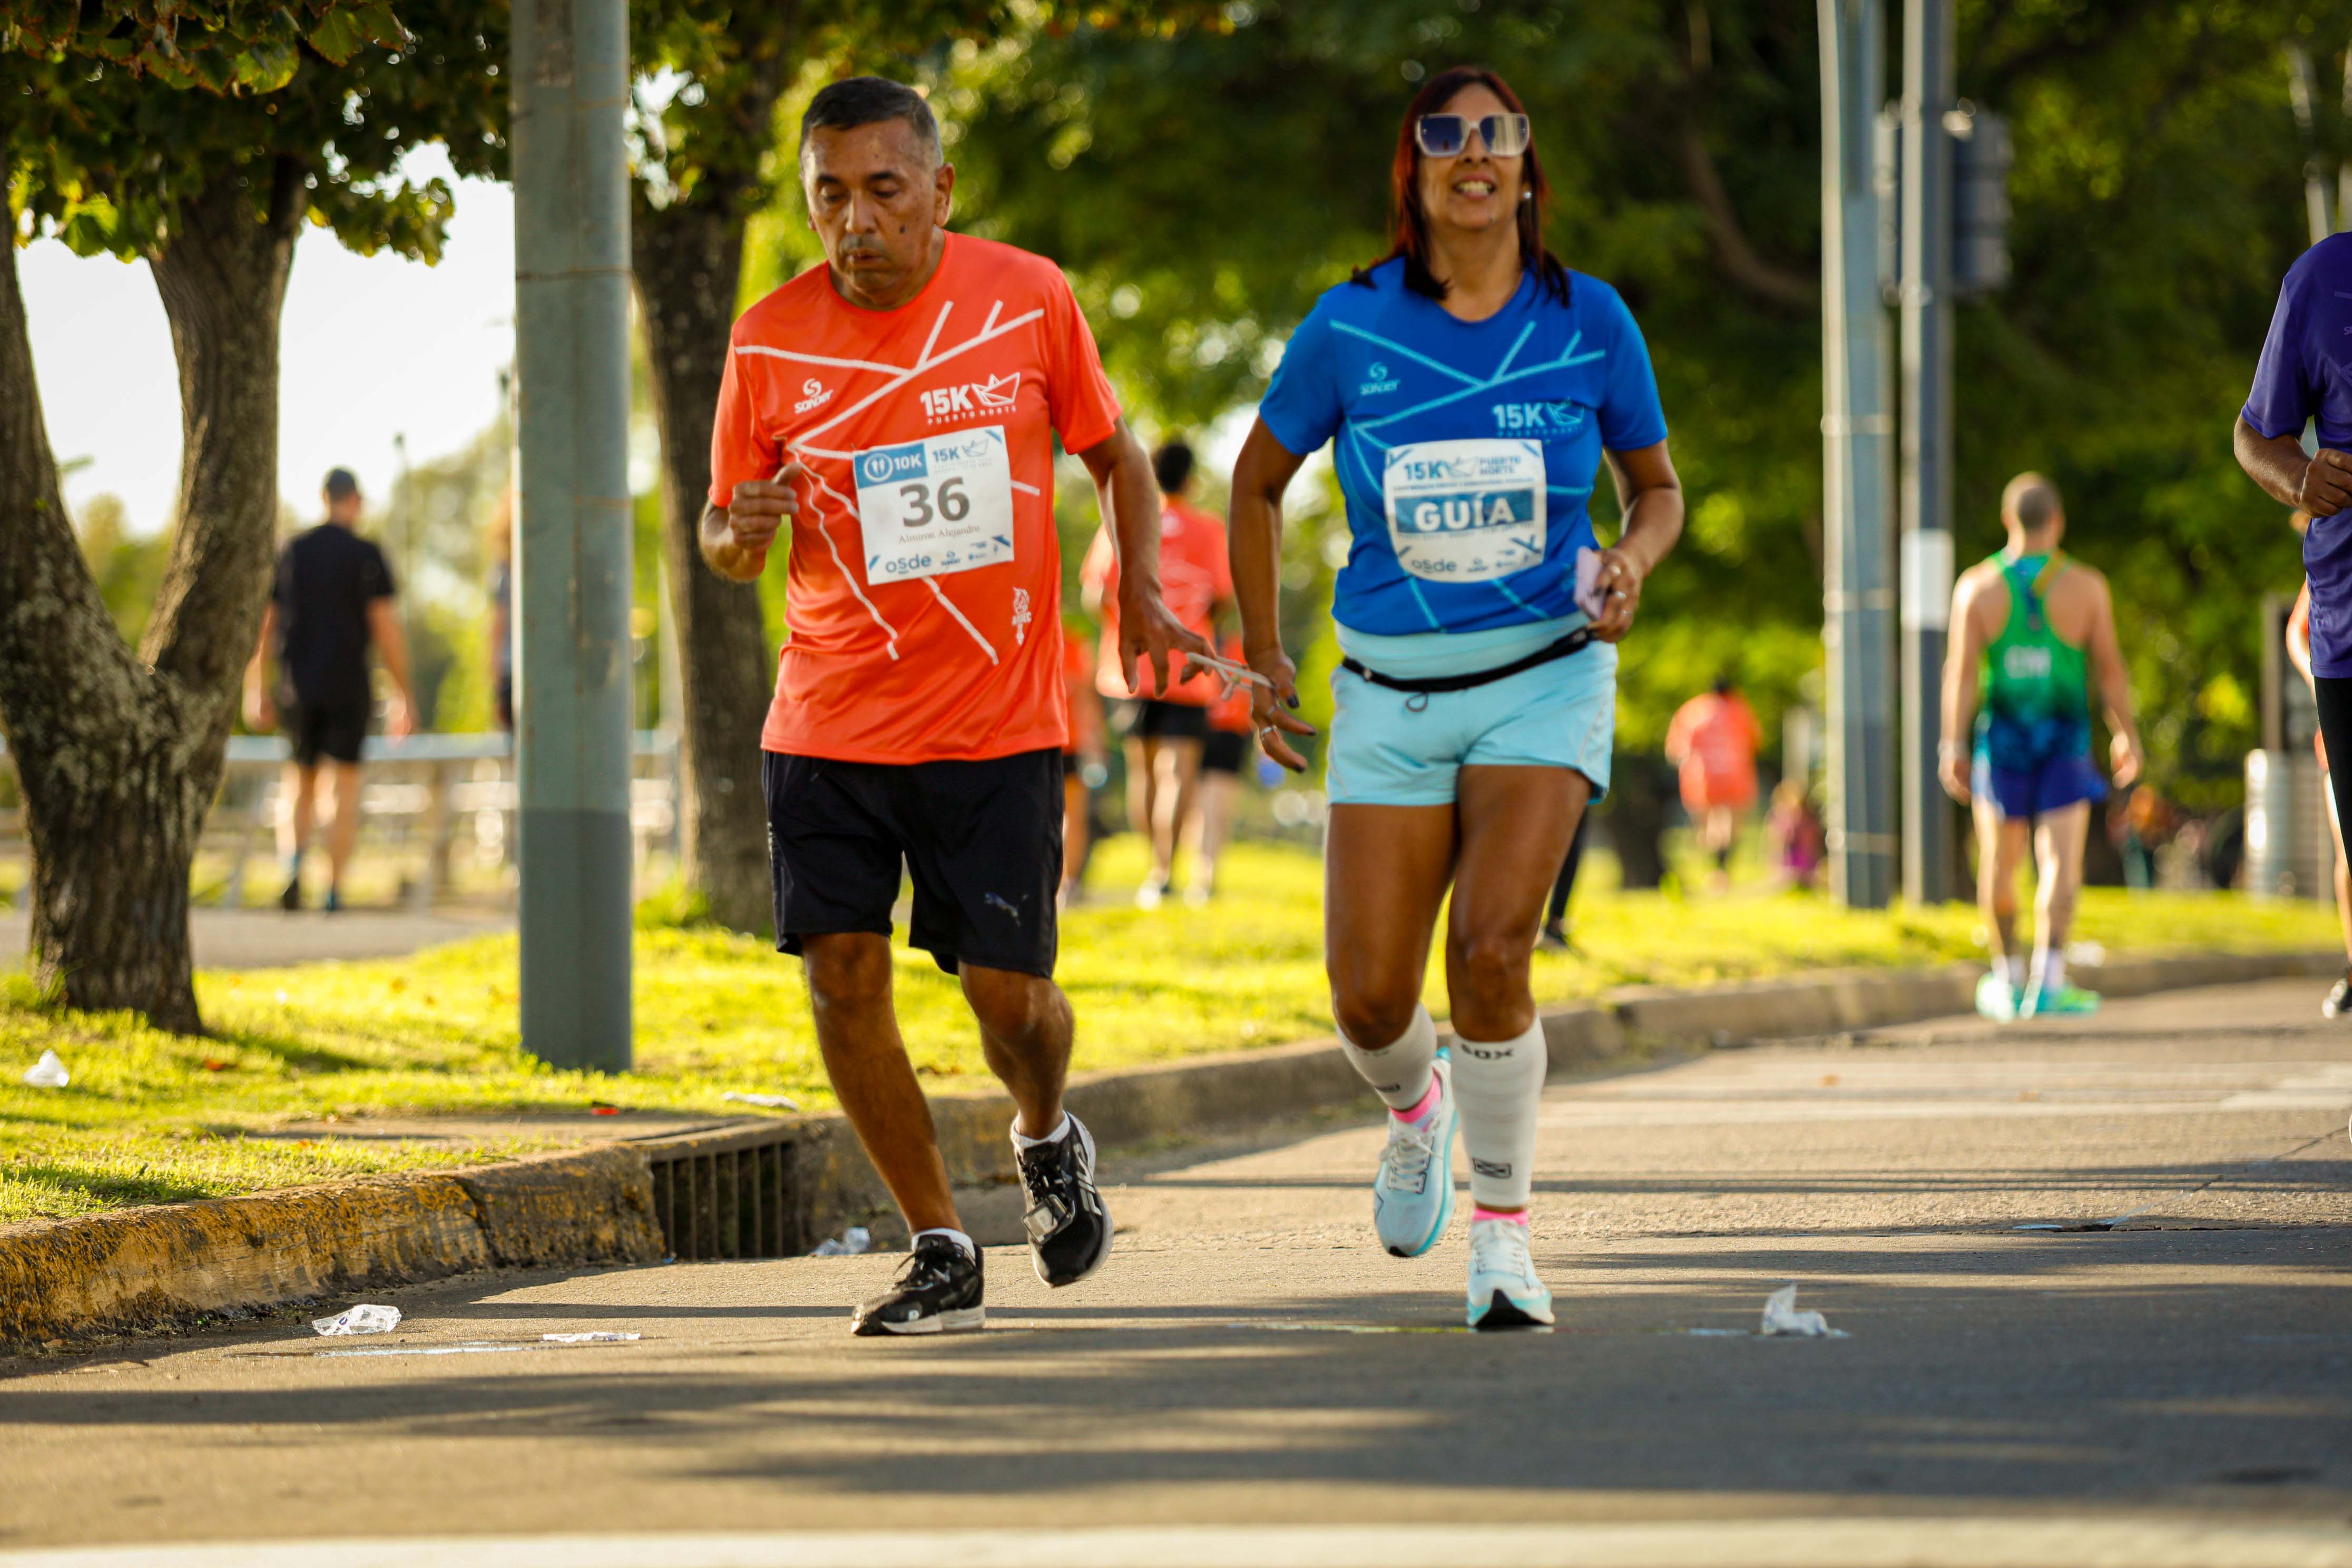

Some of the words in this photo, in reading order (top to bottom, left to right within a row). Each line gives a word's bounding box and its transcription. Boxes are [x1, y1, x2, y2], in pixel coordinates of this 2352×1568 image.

[919, 385, 974, 416] 15K
[1492, 403, 1546, 429] 15K
[894, 454, 922, 471] 10K
[932, 447, 961, 463] 15K
[1404, 460, 1446, 481] 15K
[900, 476, 970, 527] 36
[1415, 491, 1515, 532] GUÍA
[885, 554, 932, 574] osde
[1411, 558, 1458, 573] osde
